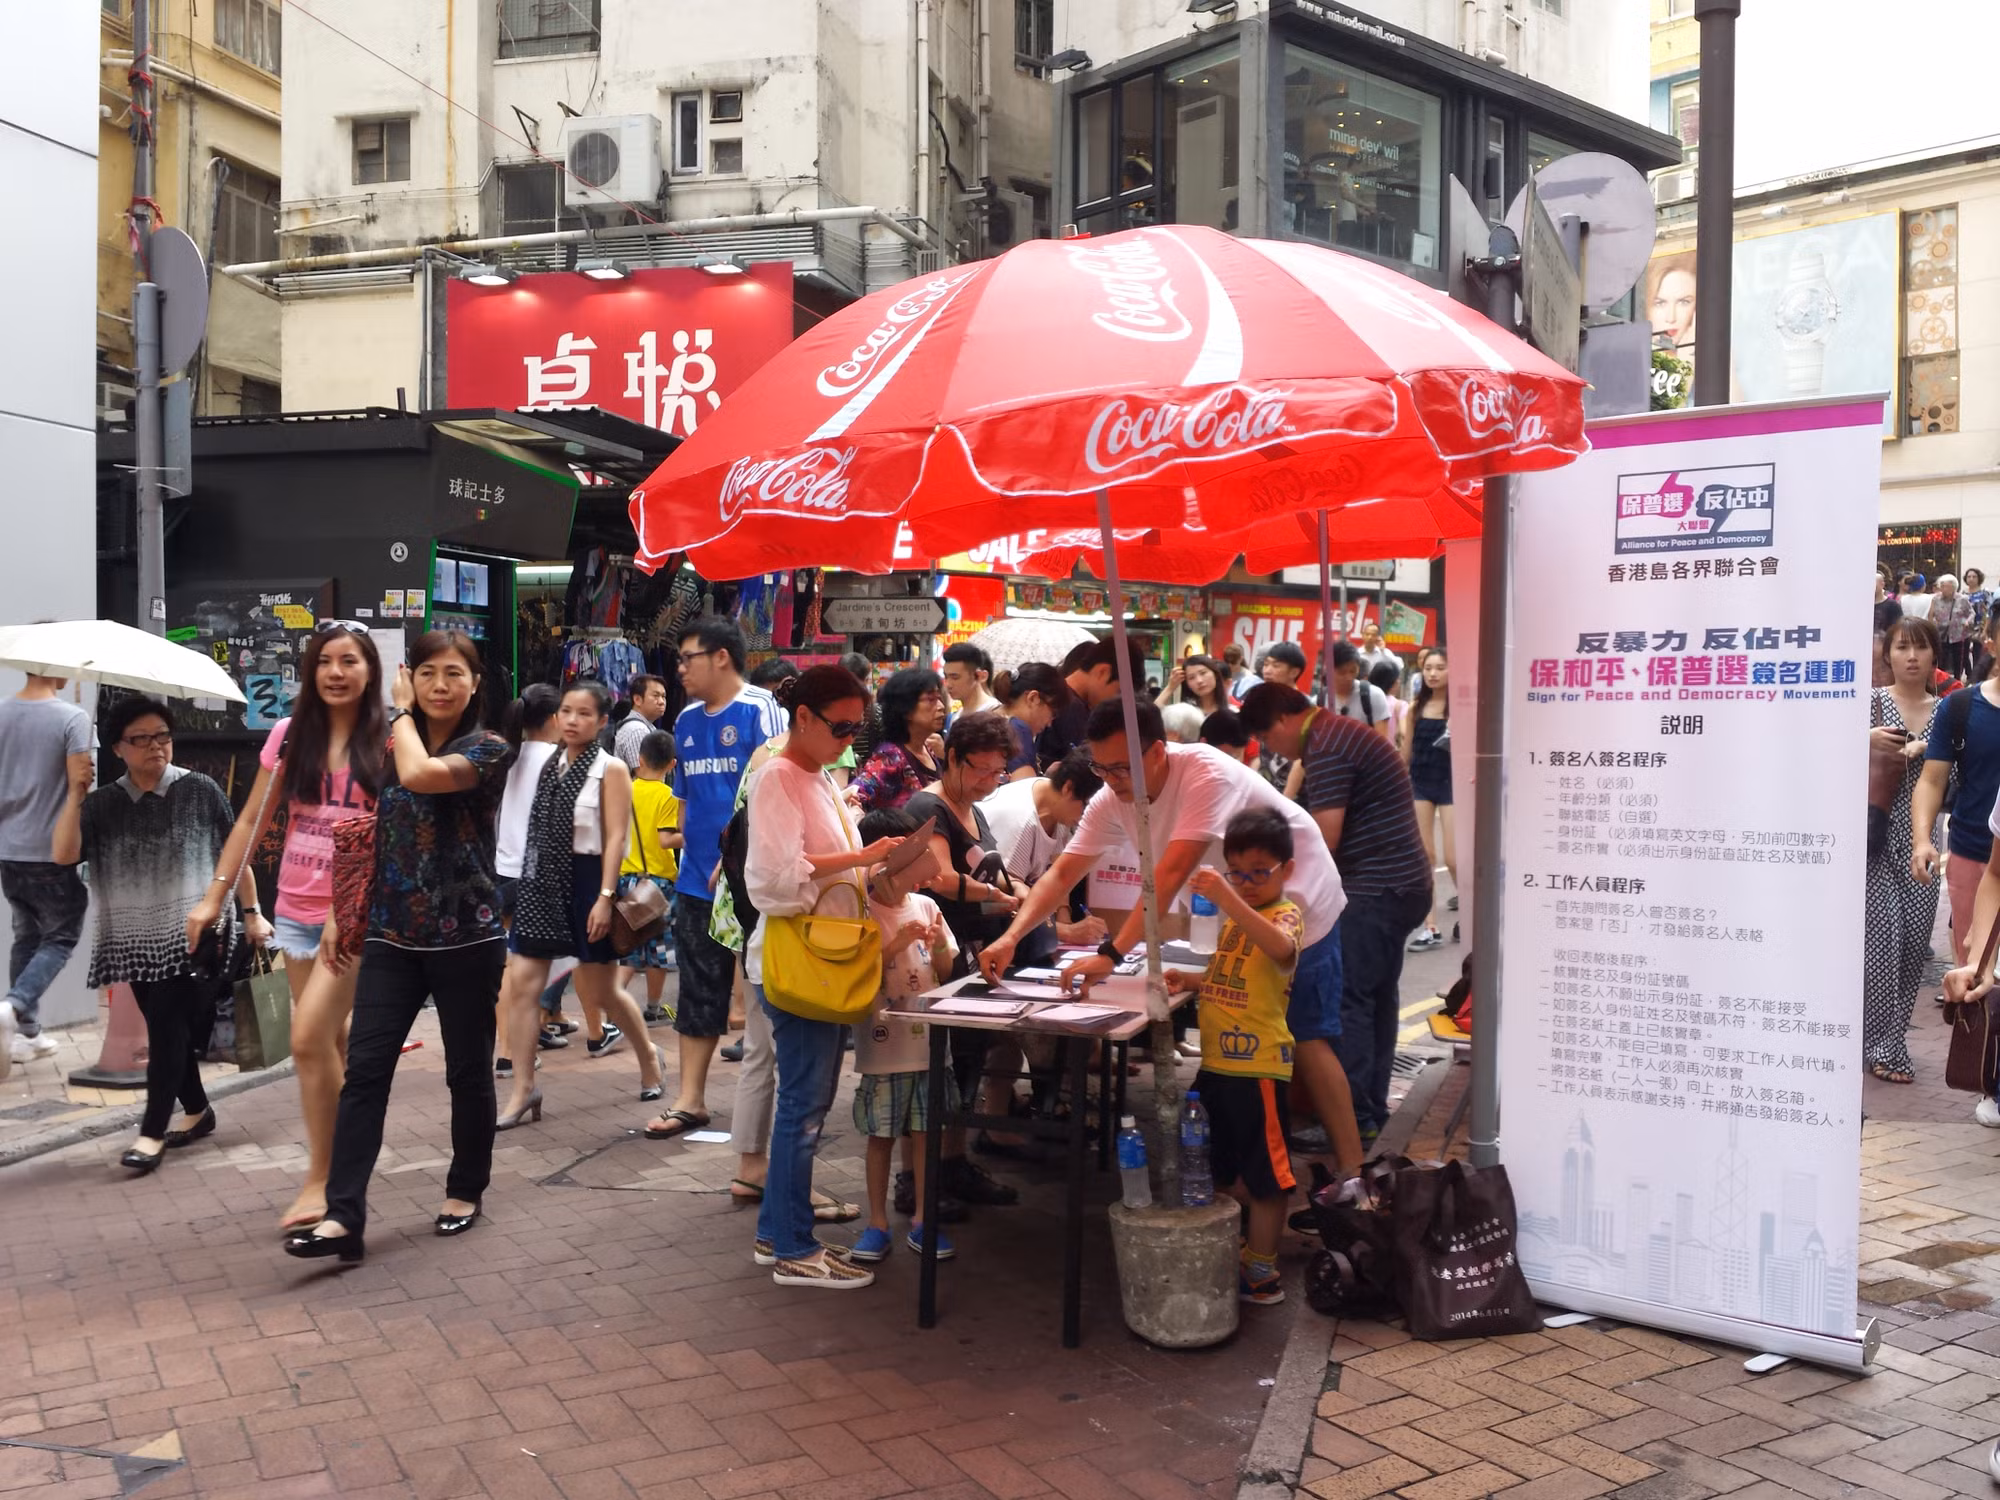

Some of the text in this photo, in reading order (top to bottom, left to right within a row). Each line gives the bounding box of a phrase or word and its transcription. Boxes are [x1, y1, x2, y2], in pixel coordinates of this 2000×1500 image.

[1330, 128, 1357, 147] mina
[1384, 145, 1399, 160] wil
[1062, 236, 1192, 341] Coca-Cola
[1085, 385, 1296, 474] Coca-Cola
[449, 477, 505, 504] 球記士多
[720, 446, 859, 522] Coca-Cola
[1622, 487, 1769, 514] 保普選 反佔中
[1621, 534, 1768, 550] Alliance for Peace and Democracy
[1608, 557, 1780, 583] 香港島各界聯合會
[836, 602, 931, 612] Jardine's Crescent
[861, 617, 906, 630] 渣甸坊
[1576, 626, 1822, 654] 反暴力 反佔中
[1527, 688, 1857, 704] Sign for Peace and Democracy Movement
[684, 757, 738, 777] SAMSUNG
[1550, 751, 1668, 768] 簽名人簽名程序
[1559, 776, 1585, 790] 姓名
[1546, 874, 1646, 895] 工作人員程序
